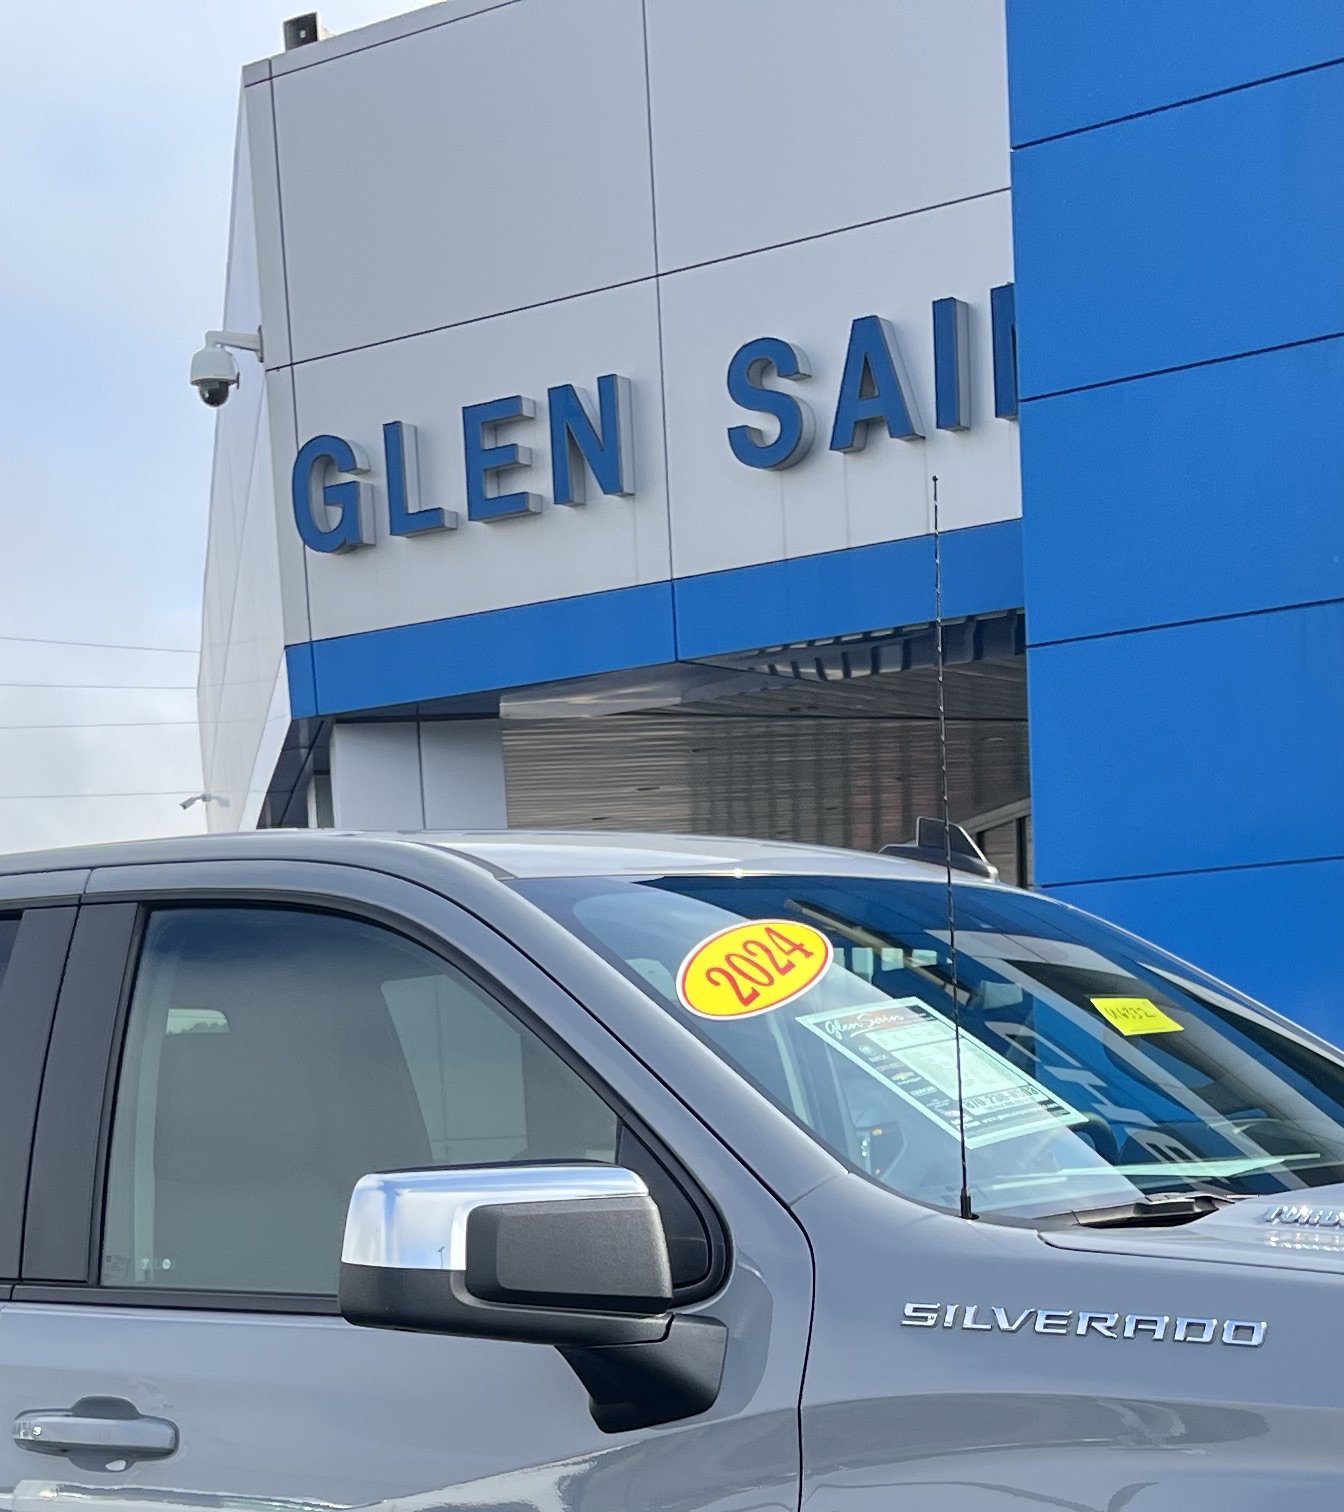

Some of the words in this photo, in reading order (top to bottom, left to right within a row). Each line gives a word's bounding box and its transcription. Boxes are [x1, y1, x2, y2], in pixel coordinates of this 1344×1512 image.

[290, 373, 634, 556] GLEN
[705, 926, 814, 1007] 2024
[900, 1301, 1271, 1348] SILVERADO
